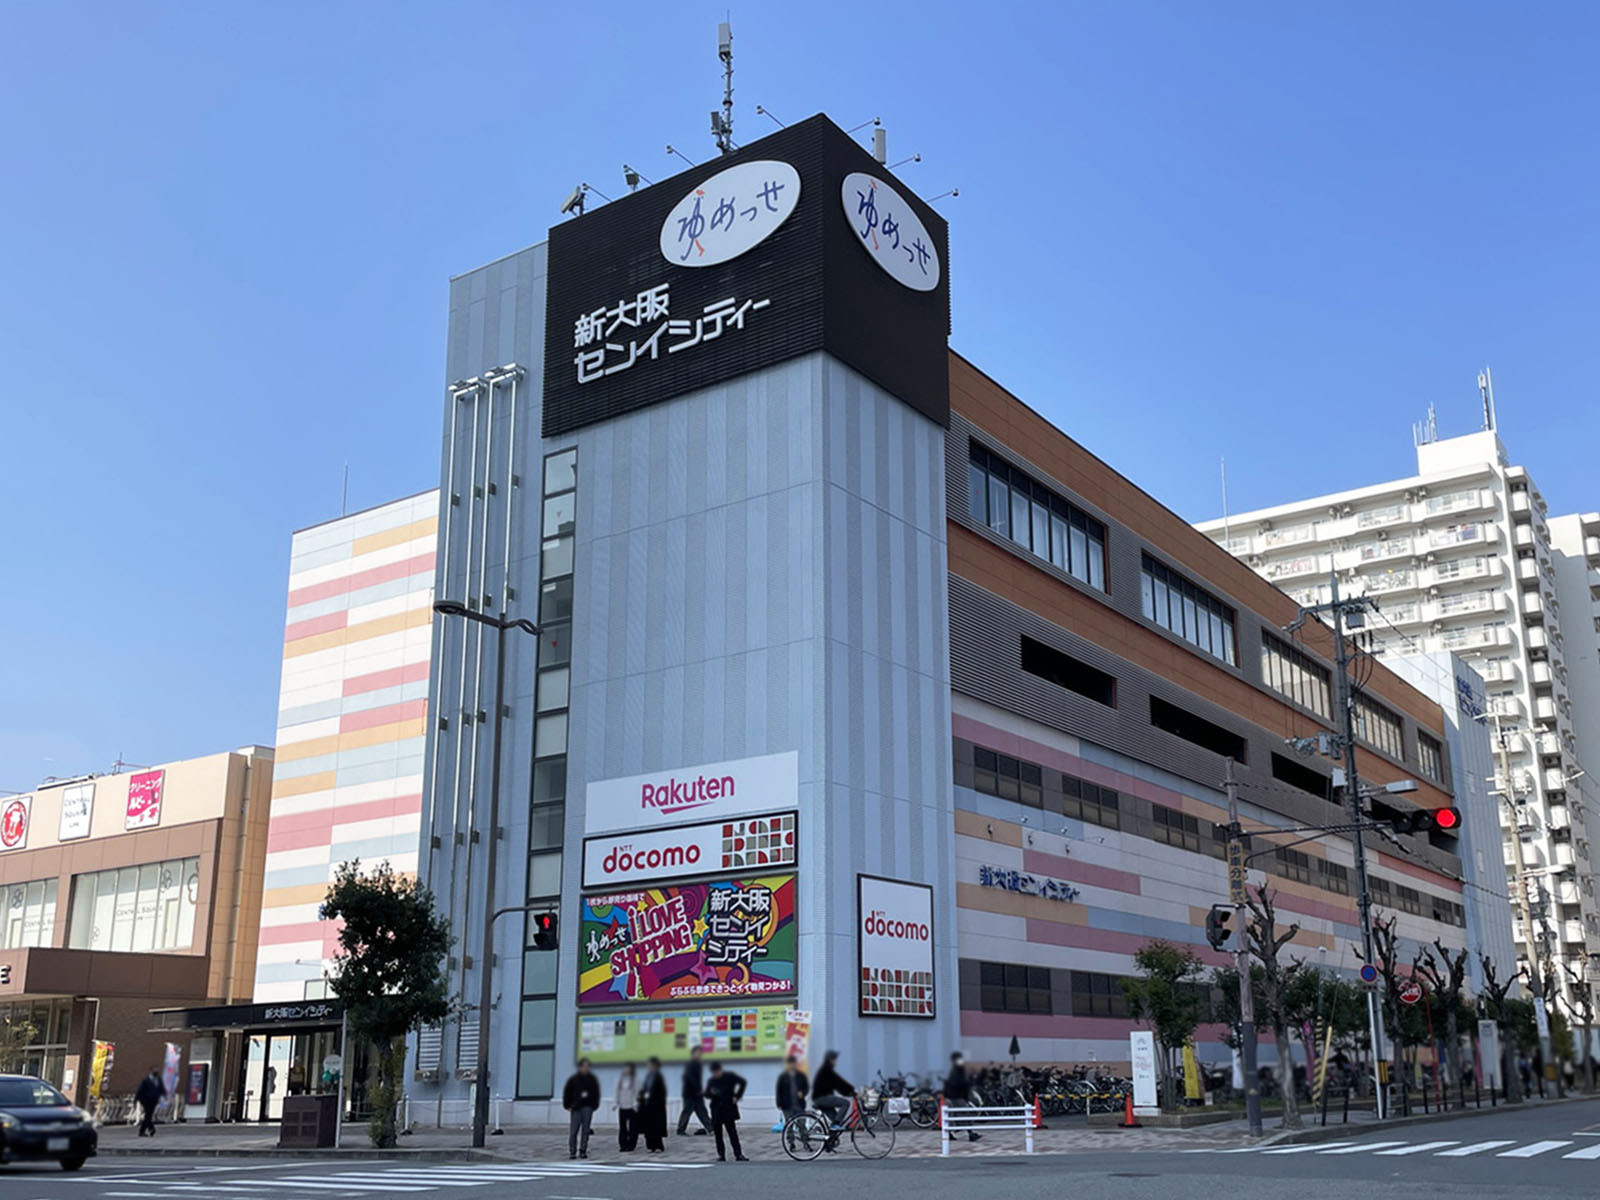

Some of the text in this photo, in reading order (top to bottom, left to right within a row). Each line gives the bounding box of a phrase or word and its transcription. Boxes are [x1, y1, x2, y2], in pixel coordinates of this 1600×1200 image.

[677, 180, 785, 261] ゆめっせ
[856, 180, 931, 275] ゆめっせ
[574, 283, 670, 347] 新大阪
[573, 298, 771, 384] センイシティー
[641, 775, 735, 809] Rakuten
[602, 844, 701, 874] docomo
[637, 896, 685, 932] LOVE
[710, 888, 770, 912] 新大阪
[709, 914, 768, 938] センイ
[864, 910, 929, 942] docomo
[586, 927, 627, 962] ゆめっせ
[707, 939, 768, 963] シティー
